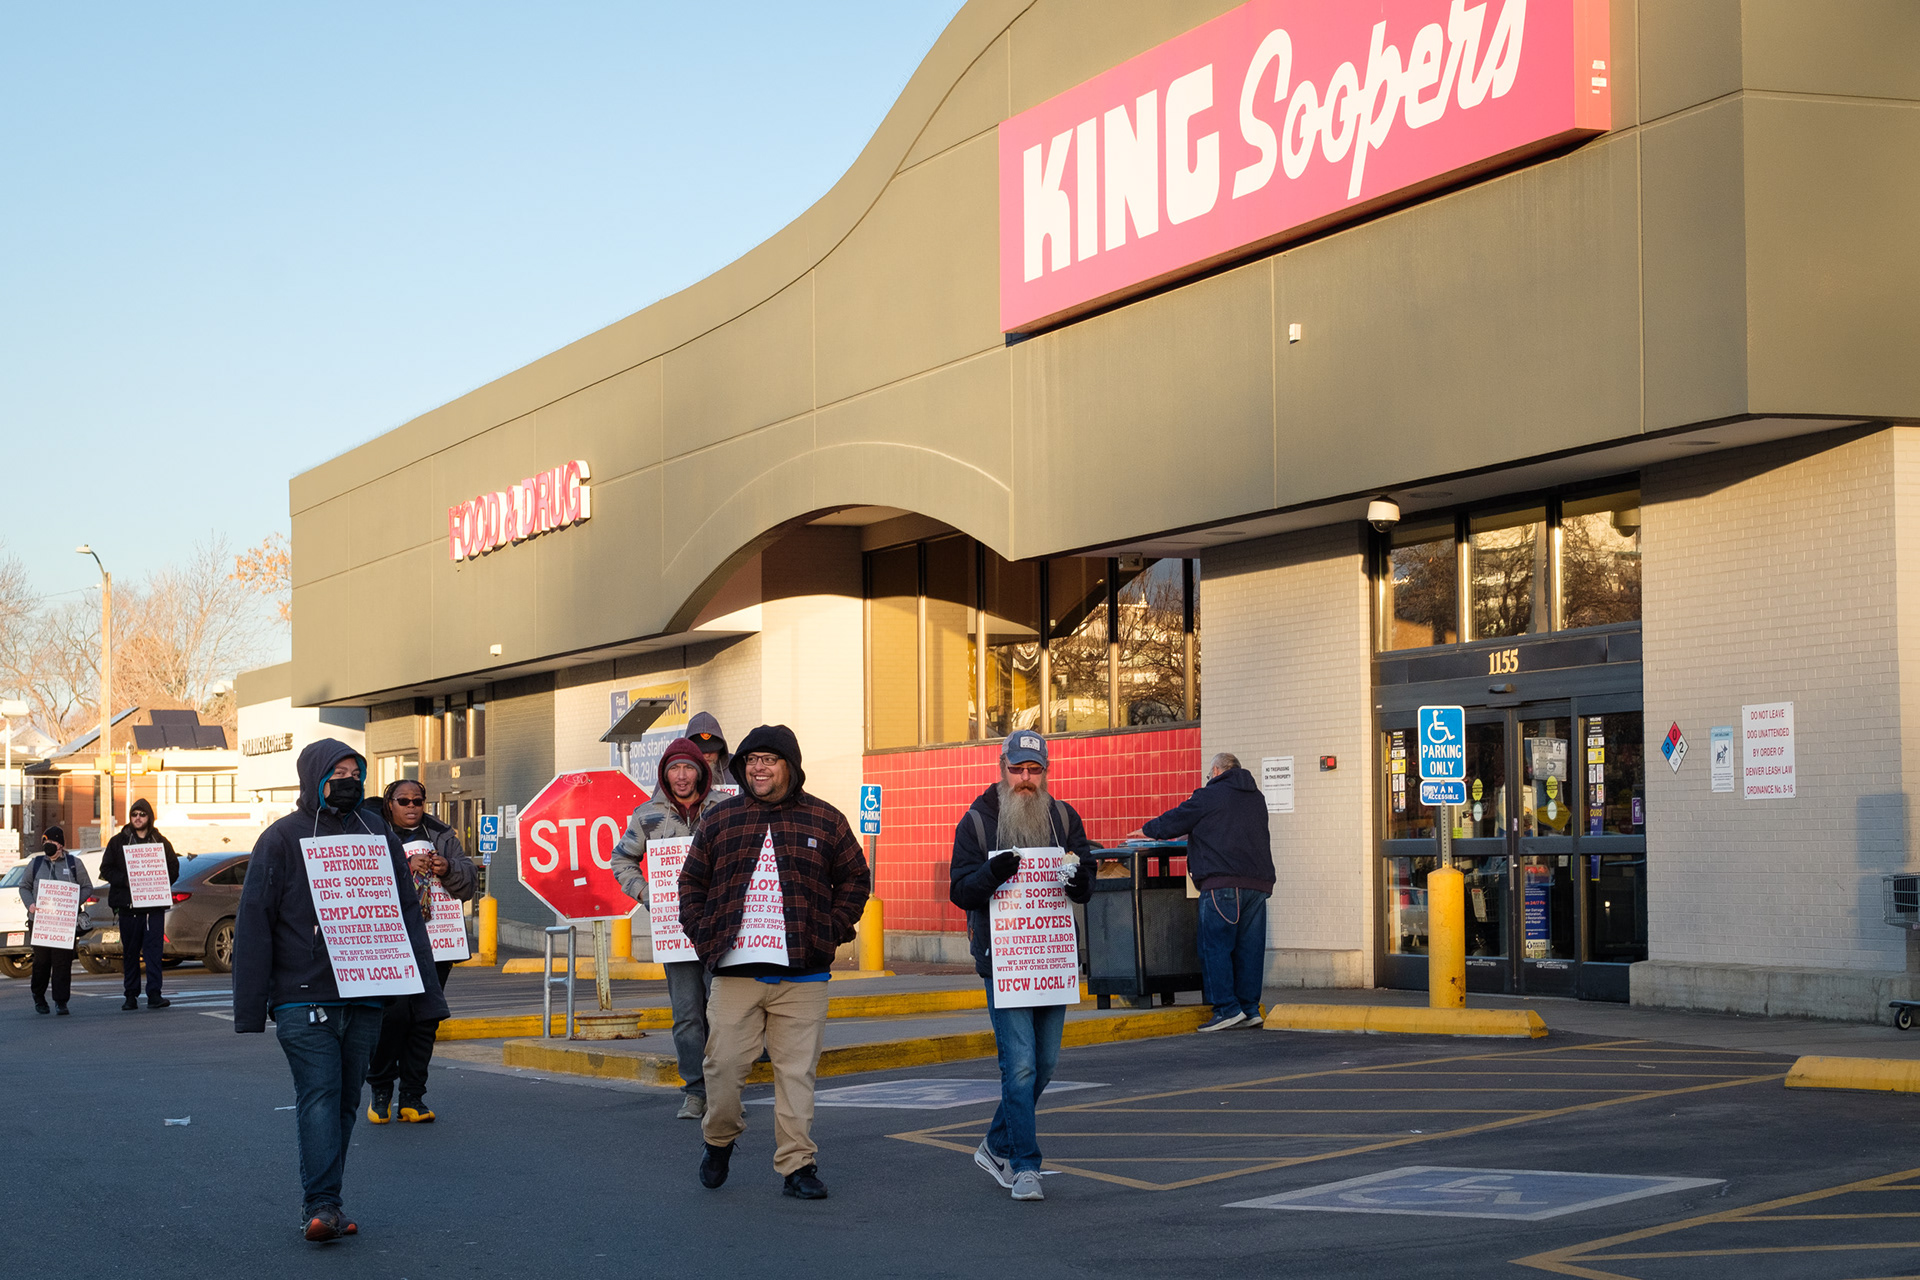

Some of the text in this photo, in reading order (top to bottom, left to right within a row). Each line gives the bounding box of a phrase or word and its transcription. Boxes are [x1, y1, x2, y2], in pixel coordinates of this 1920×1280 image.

[1024, 0, 1526, 283] KING Soopers
[448, 460, 590, 560] FOOD & DRUG
[1489, 648, 1519, 674] 1155
[1751, 709, 1784, 720] DO NOT LEAVE
[1672, 728, 1677, 740] 0
[1747, 728, 1789, 739] DOG UNATTENDED
[1422, 744, 1461, 758] PARKING
[1665, 742, 1684, 754] 3 2
[1753, 747, 1784, 757] BY ORDER OF
[1430, 761, 1454, 775] ONLY
[1746, 766, 1792, 776] DENVER LEASH LAW
[1747, 786, 1773, 795] ORDINANCE
[1783, 784, 1793, 793] 8-16
[861, 810, 880, 820] PARKING
[865, 822, 877, 832] ONLY
[530, 815, 632, 873] STO
[306, 845, 386, 859] PLEASE DO NOT
[650, 845, 682, 856] PLEASE
[323, 859, 379, 872] PATRONIZE
[1038, 858, 1050, 869] DO
[1052, 857, 1062, 868] NO
[651, 870, 673, 879] KING
[312, 876, 393, 889] KING SOOPER'S
[655, 880, 673, 888] (Div.
[320, 888, 391, 901] (Div. of Kroger)
[993, 888, 1068, 900] KING SOOPER'
[998, 899, 1067, 912] (Div. of Kroger)
[319, 905, 399, 921] EMPLOYEES
[436, 912, 460, 920] STRIKE
[652, 914, 680, 923] PRACT
[324, 923, 404, 934] ON UNFAIR LABOR
[994, 915, 1072, 931] EMPLOYEES
[327, 934, 406, 945] PRACTICE STRIKE
[656, 939, 681, 951] UFCW
[748, 935, 783, 950] LOCAL
[994, 933, 1074, 945] ON UNFAIR LABOR
[995, 944, 1074, 956] PRACTICE STRIKE
[336, 965, 414, 982] UFCW LOCAL #7
[998, 976, 1076, 992] UFCW LOCAL #7
